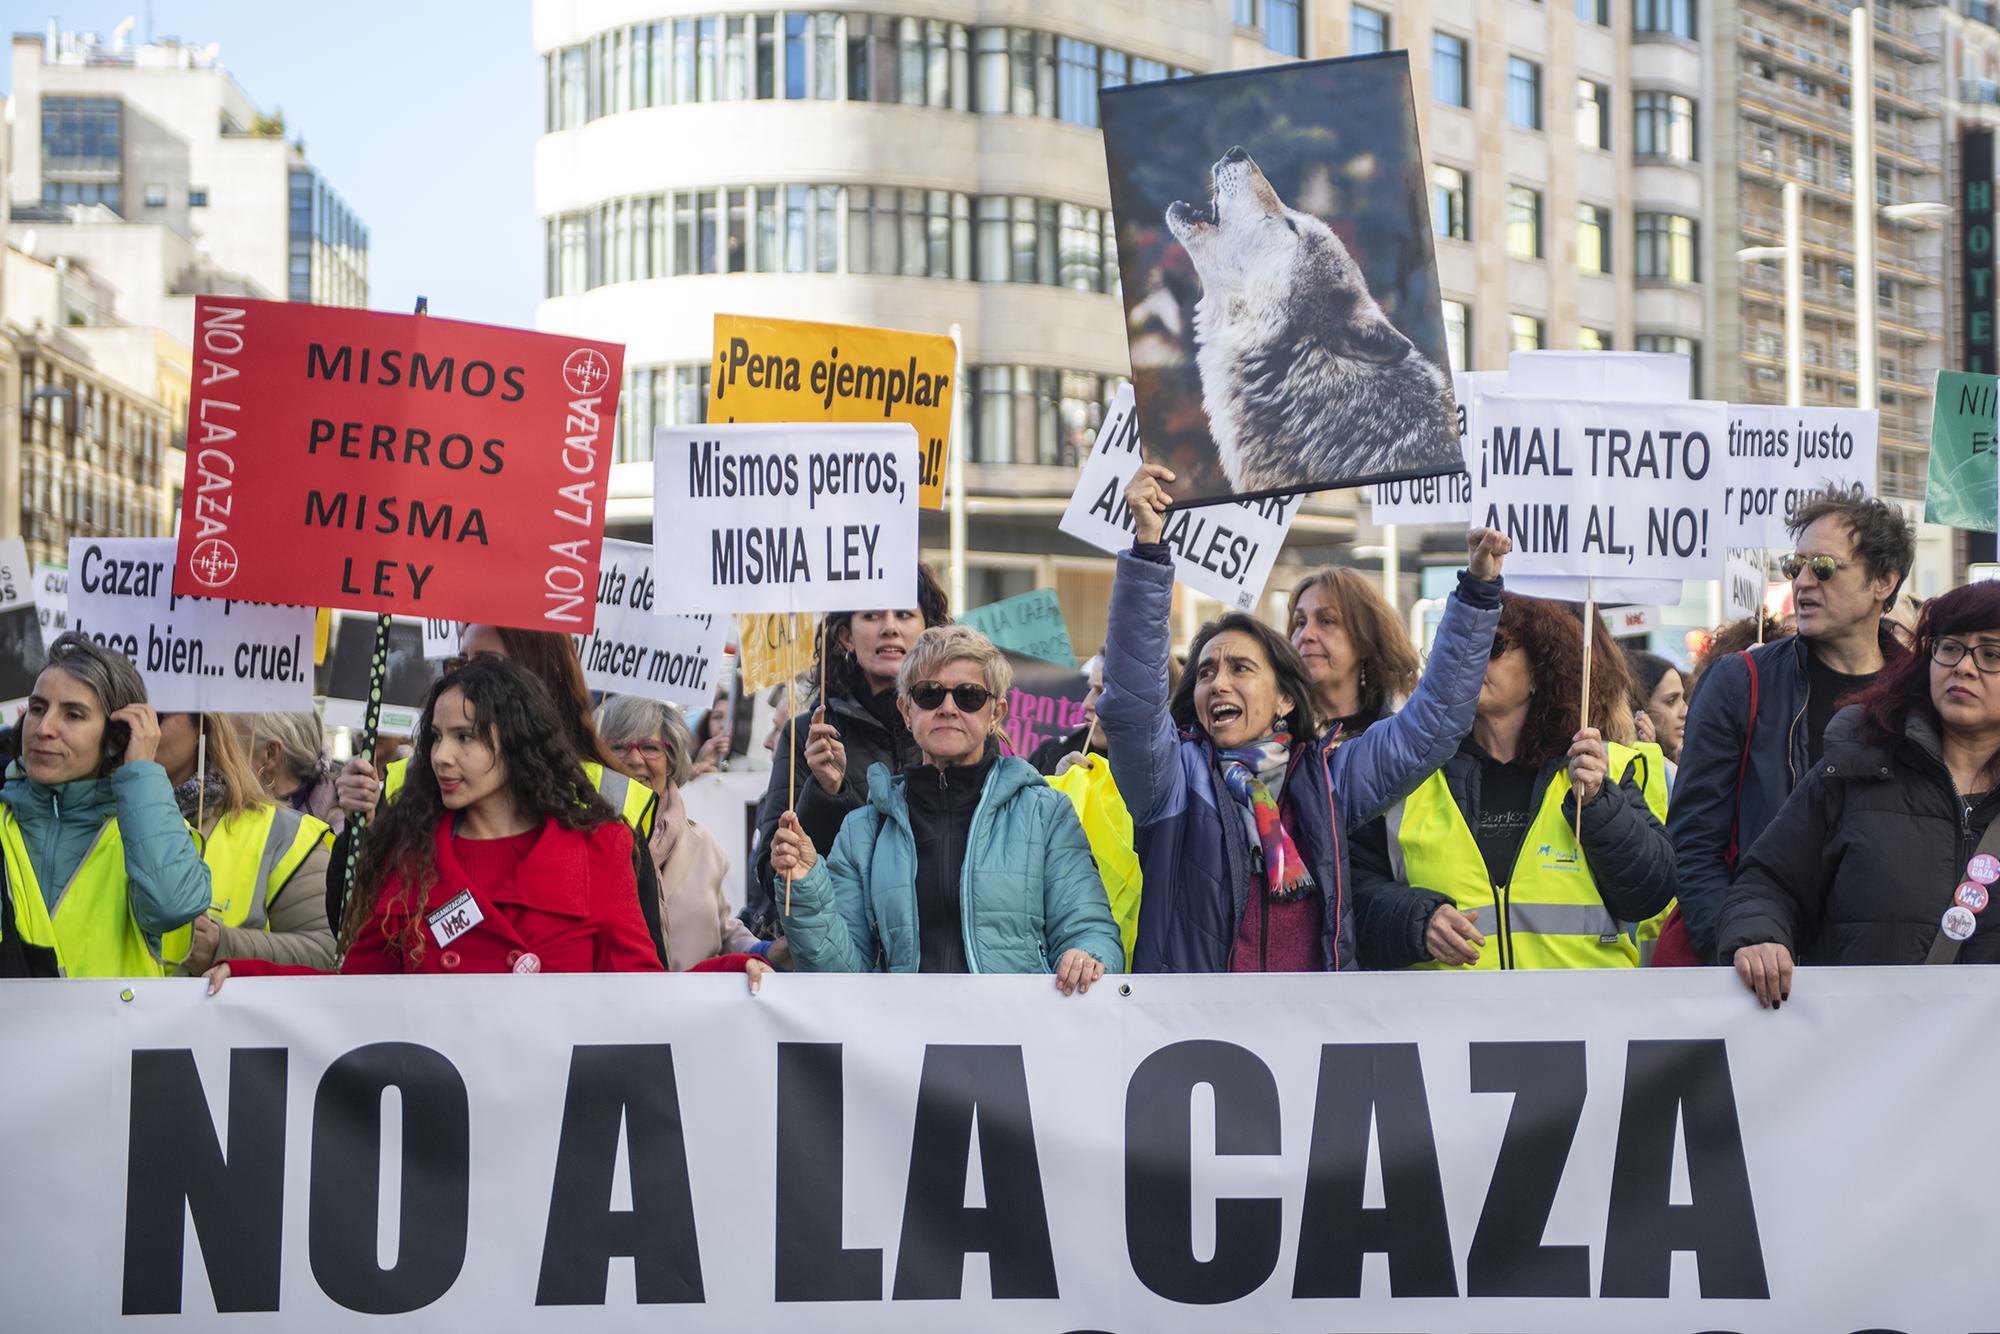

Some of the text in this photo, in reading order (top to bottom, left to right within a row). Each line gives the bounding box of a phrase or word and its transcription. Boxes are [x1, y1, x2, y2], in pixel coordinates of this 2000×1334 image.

[306, 342, 526, 402] MISMOS
[716, 337, 949, 417] ¡Pena ejemplar
[195, 305, 246, 539] NO A LA CAZA
[307, 418, 505, 475] PERROS
[1794, 419, 1854, 468] justo
[689, 440, 905, 510] Mismos perros,
[1480, 426, 1711, 488] ¡MAL TRATO
[304, 489, 489, 546] MISMA
[544, 397, 602, 623] NO A LA CAZA
[1089, 475, 1259, 585] ANALES!
[1582, 505, 1635, 566] AL,
[1647, 507, 1709, 559] NO!
[1740, 486, 1778, 525] por
[81, 545, 163, 597] Cazar
[341, 556, 434, 600] LEY
[711, 524, 884, 585] MISMA LEY.
[1016, 595, 1060, 625] CAZA
[146, 623, 225, 677] bien...
[234, 634, 305, 683] cruel.
[586, 627, 648, 679] hacer
[647, 645, 709, 691] morir.
[121, 1039, 1771, 1316] NO A LA CAZA
